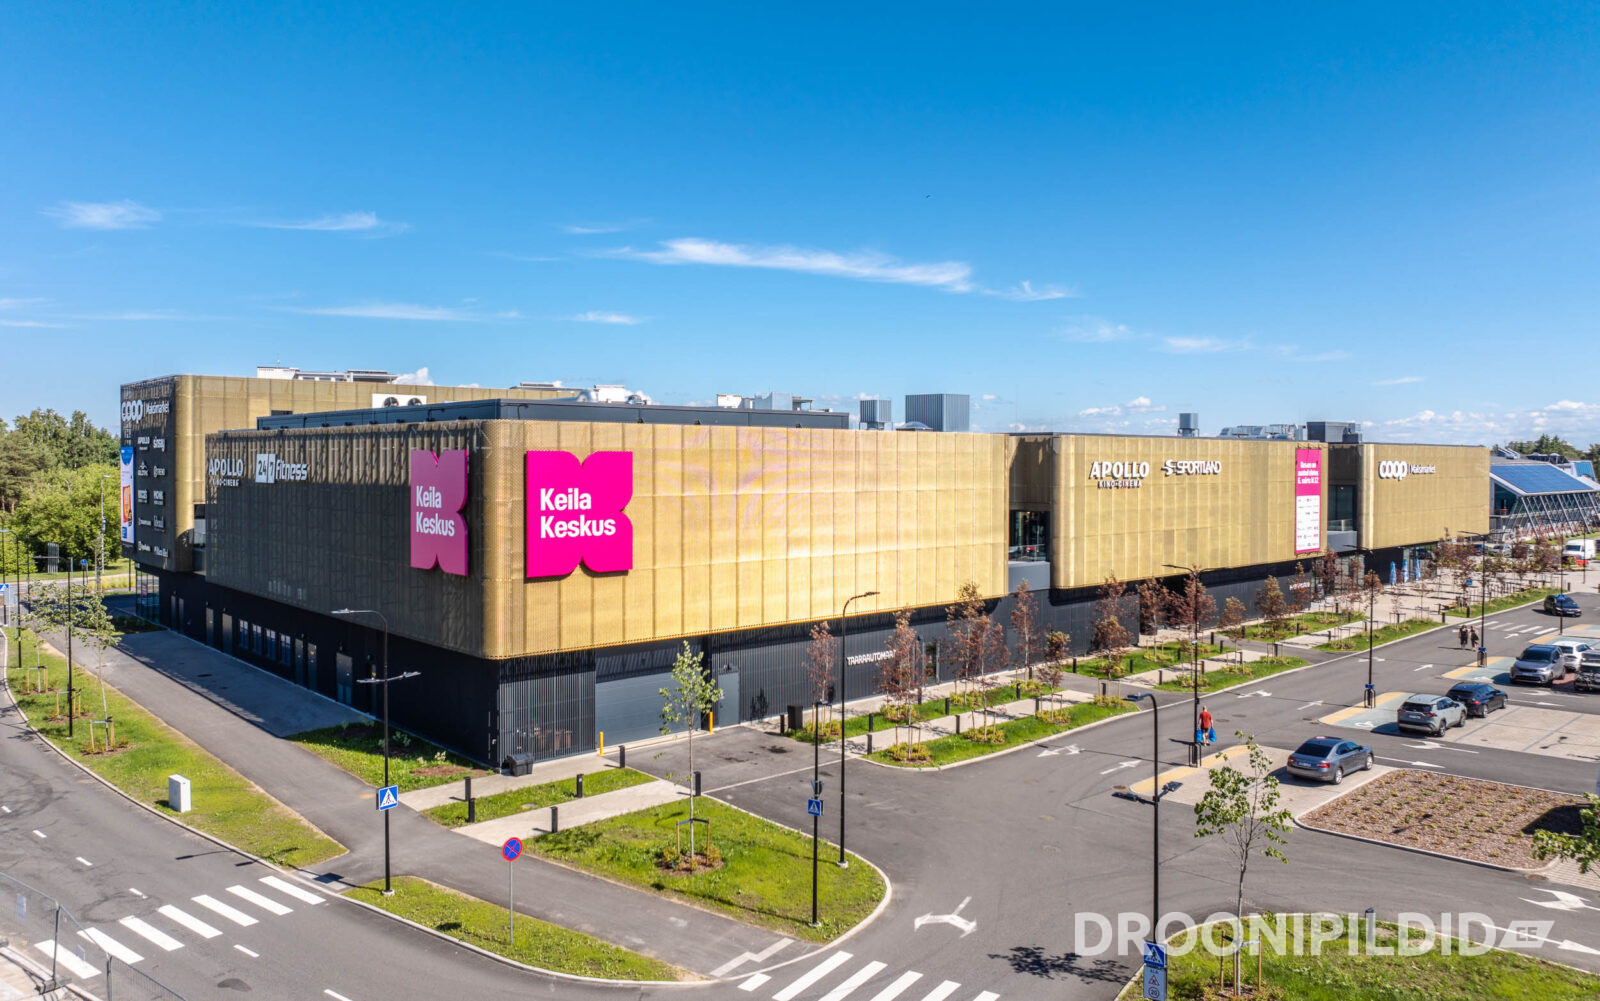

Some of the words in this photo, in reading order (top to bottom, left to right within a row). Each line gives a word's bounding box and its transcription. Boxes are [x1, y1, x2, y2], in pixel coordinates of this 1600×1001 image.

[208, 458, 244, 477] APOLLO
[1090, 461, 1150, 478] APOLLO
[1176, 460, 1222, 475] SPORTLAND
[416, 485, 442, 509] Keila
[540, 488, 592, 511] Keila
[416, 512, 455, 537] Keskus
[540, 515, 616, 539] Keskus
